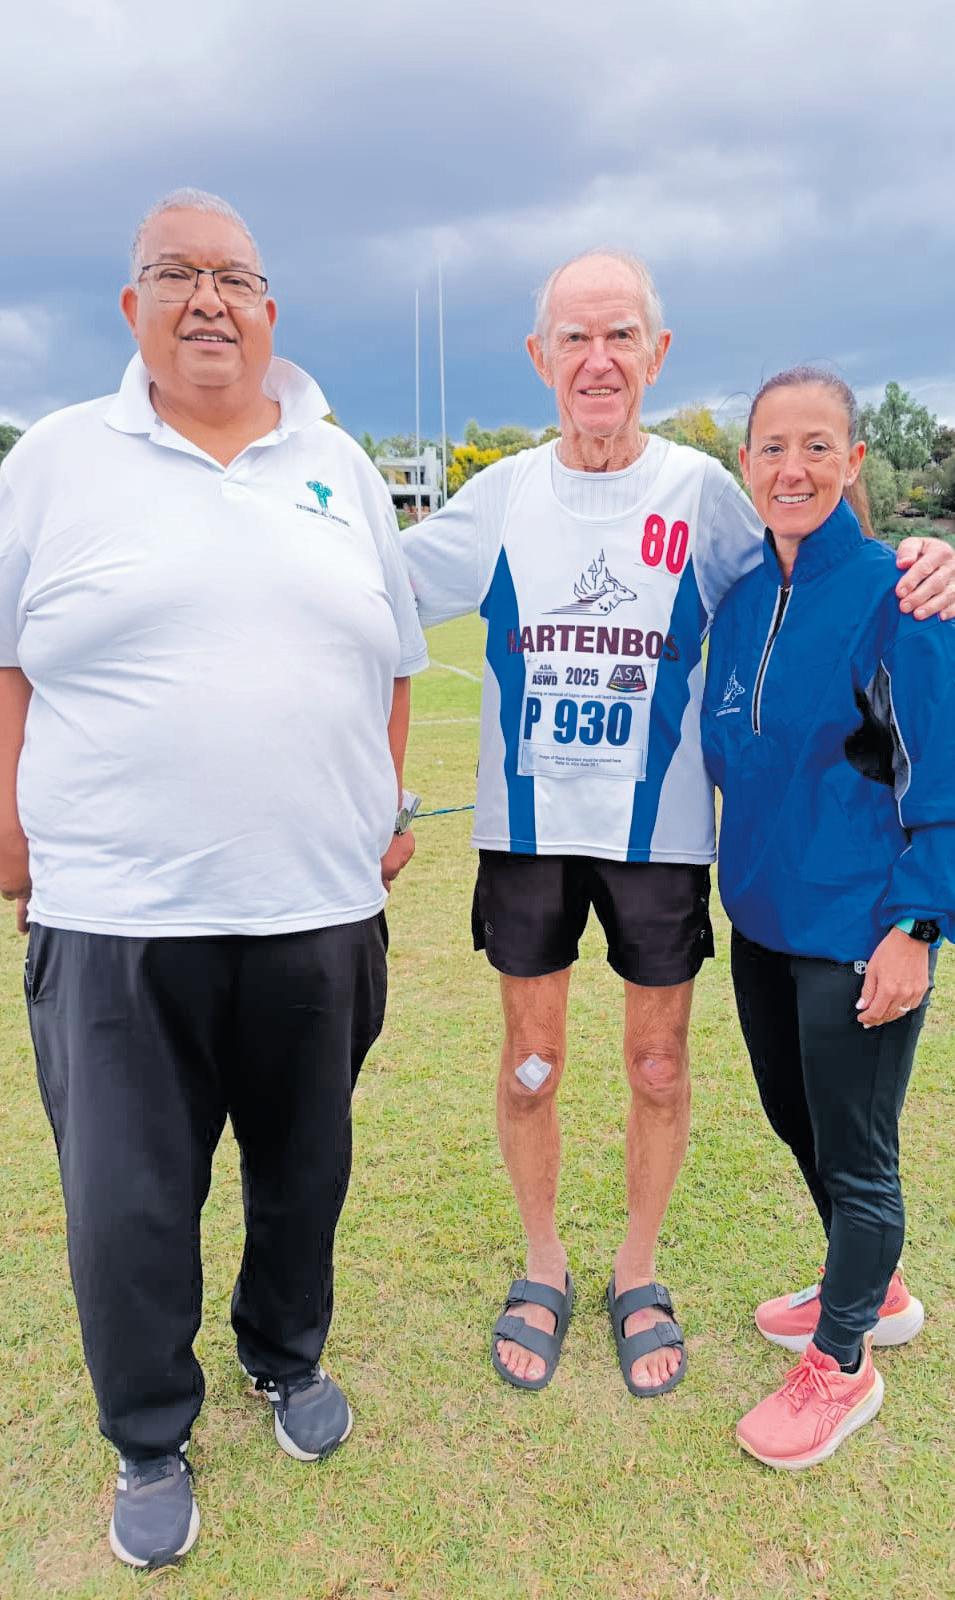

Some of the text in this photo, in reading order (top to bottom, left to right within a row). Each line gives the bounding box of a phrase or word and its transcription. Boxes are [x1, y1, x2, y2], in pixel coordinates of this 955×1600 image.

[641, 513, 689, 575] 80
[532, 675, 558, 686] ASWD
[565, 667, 599, 686] 2025
[613, 667, 645, 681] ASA
[523, 697, 632, 747] P 930
